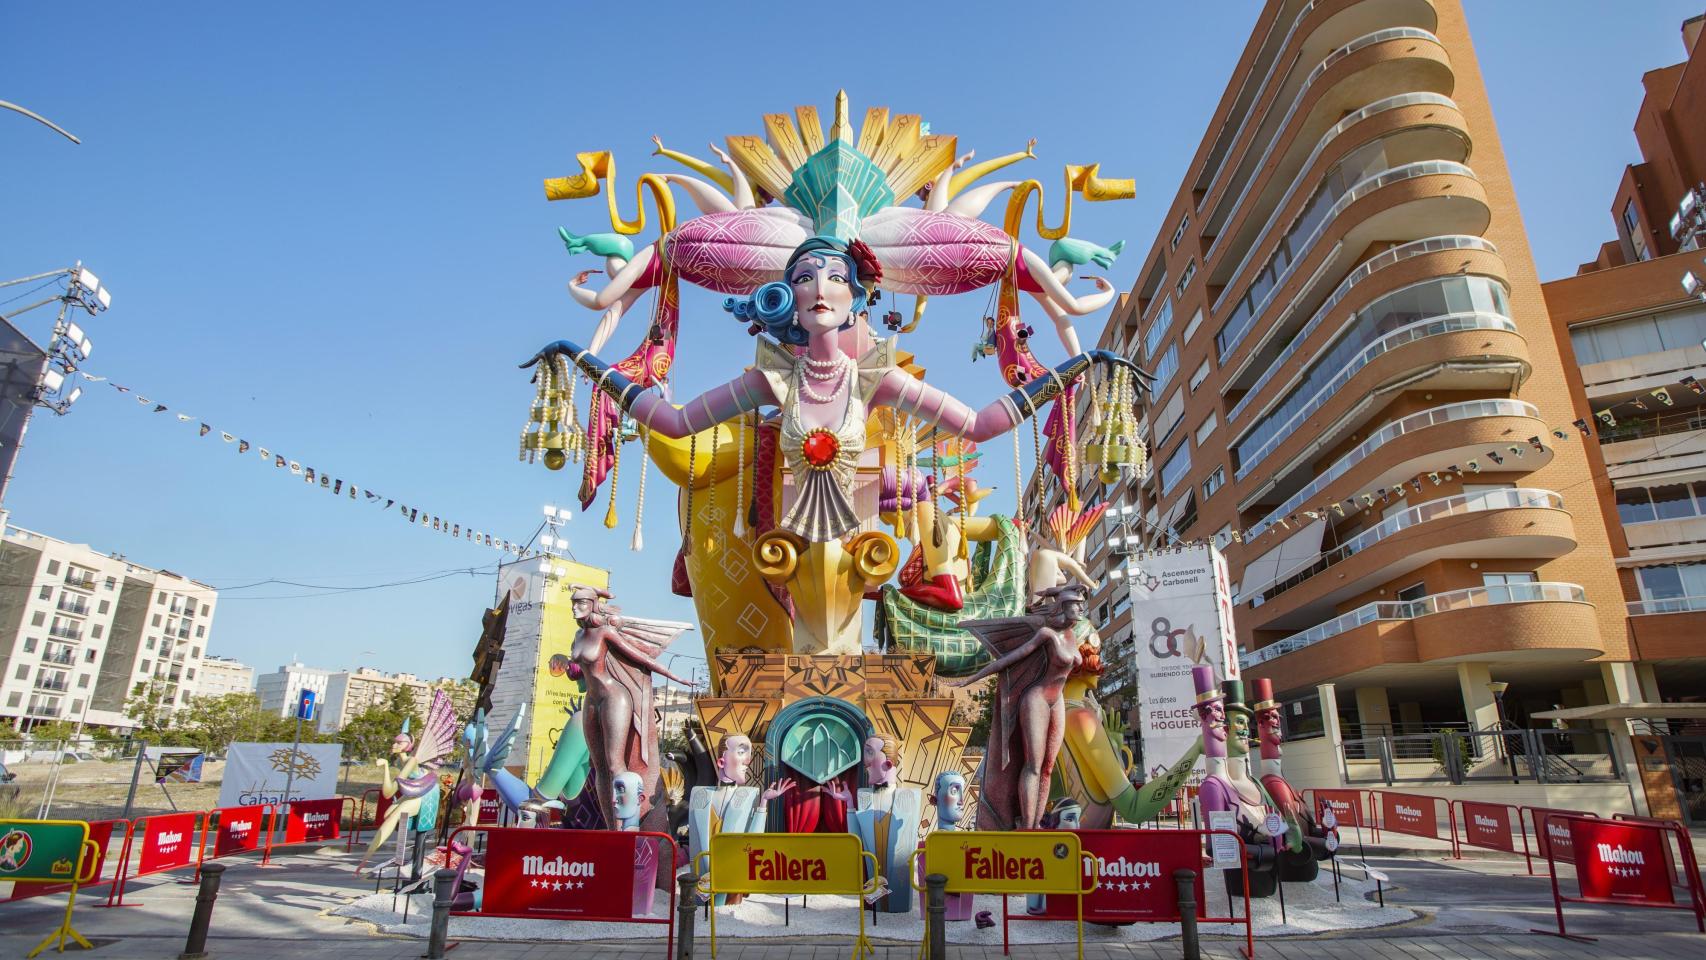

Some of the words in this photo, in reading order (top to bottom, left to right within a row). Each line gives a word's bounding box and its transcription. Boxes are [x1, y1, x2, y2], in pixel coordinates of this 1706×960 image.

[1161, 567, 1206, 578] Ascensores
[1162, 576, 1199, 587] Carbonell
[508, 601, 533, 615] vigas
[1150, 670, 1181, 678] SUBIENDO
[1159, 695, 1177, 704] desea
[1395, 804, 1422, 818] Mahou
[303, 812, 330, 825] Mahou
[1474, 814, 1499, 828] Mahou
[230, 820, 253, 833] Mahou
[157, 830, 183, 846] Mahou
[1597, 843, 1645, 866] Mahou
[522, 855, 596, 877] Mahou
[748, 849, 827, 881] Fallera
[965, 847, 1045, 880] Fallera
[1083, 856, 1162, 877] Mahou
